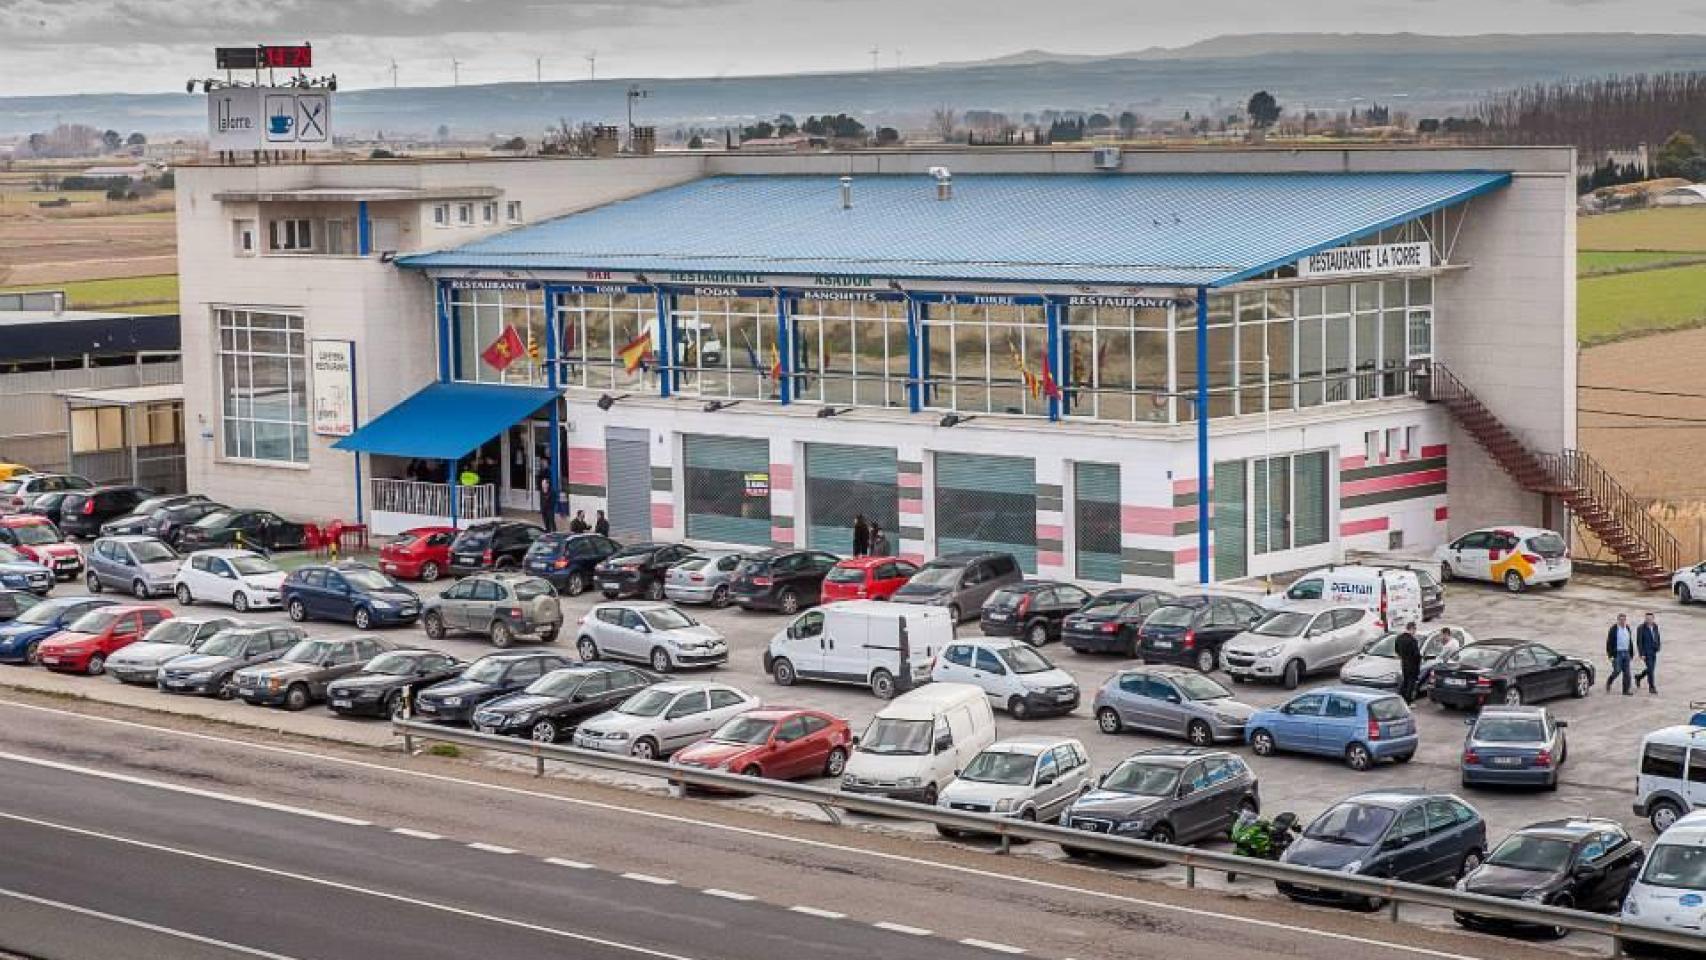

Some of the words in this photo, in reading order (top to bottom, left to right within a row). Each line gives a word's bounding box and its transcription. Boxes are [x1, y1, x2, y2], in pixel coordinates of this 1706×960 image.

[1309, 248, 1372, 272] RESTAURANTE
[1376, 248, 1389, 267] LA
[1391, 246, 1421, 266] TORRE
[694, 287, 739, 297] BODAS
[804, 290, 877, 301] BANQUETES
